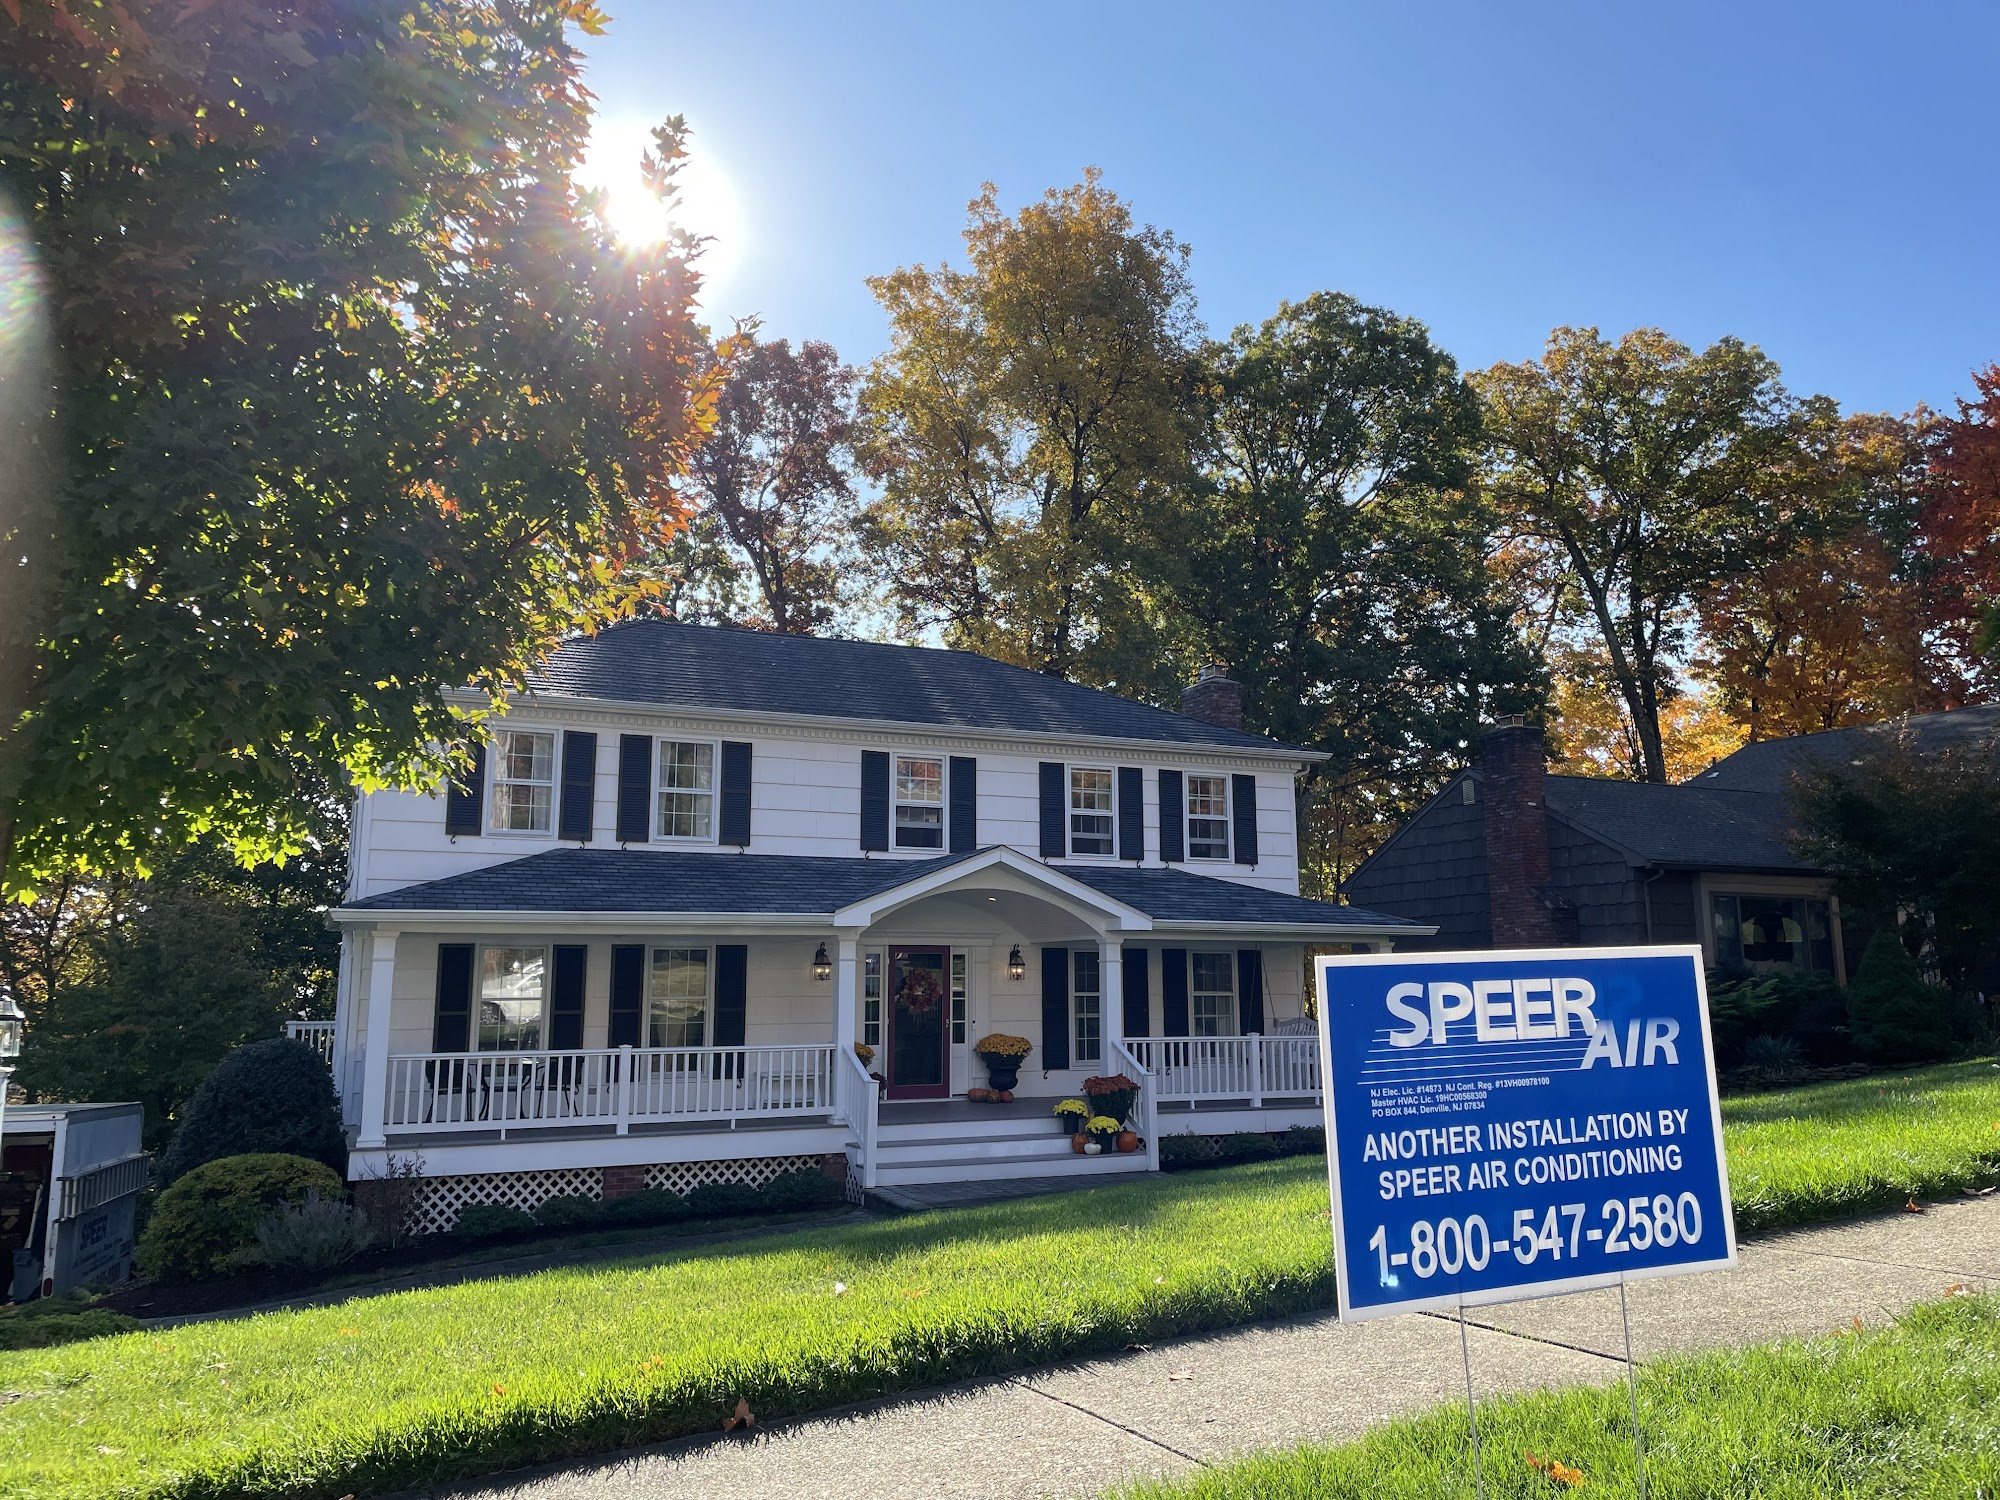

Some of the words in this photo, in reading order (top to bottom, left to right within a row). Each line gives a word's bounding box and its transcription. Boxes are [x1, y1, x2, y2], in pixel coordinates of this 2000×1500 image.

[1386, 977, 1599, 1048] SPEER
[1580, 1017, 1680, 1069] AIR
[1371, 1089, 1381, 1097] NJ
[1383, 1087, 1400, 1096] Elec.
[1402, 1087, 1416, 1095] Lic.
[1417, 1085, 1442, 1094] #14873
[1446, 1084, 1455, 1092] NJ
[1457, 1083, 1476, 1091] Cont.
[1478, 1081, 1494, 1090] Reg.
[1495, 1077, 1550, 1088] #13VH00978100
[1372, 1098, 1396, 1107] Master
[1398, 1097, 1418, 1105] HVAC
[1421, 1096, 1433, 1104] Lic.
[1372, 1109, 1383, 1117] PO
[1385, 1108, 1402, 1116] BOX
[1404, 1107, 1419, 1115] 844,
[1420, 1105, 1451, 1114] Denville,
[1453, 1103, 1462, 1111] NJ
[1464, 1102, 1485, 1110] 07834
[1363, 1126, 1483, 1162] ANOTHER
[1488, 1111, 1653, 1150] INSTALLATION
[1659, 1109, 1689, 1135] BY
[1378, 1165, 1462, 1200] SPEER
[1468, 1161, 1508, 1191] AIR
[1514, 1145, 1682, 1186] CONDITIONING
[1369, 1191, 1702, 1287] 1-800-547-2580
